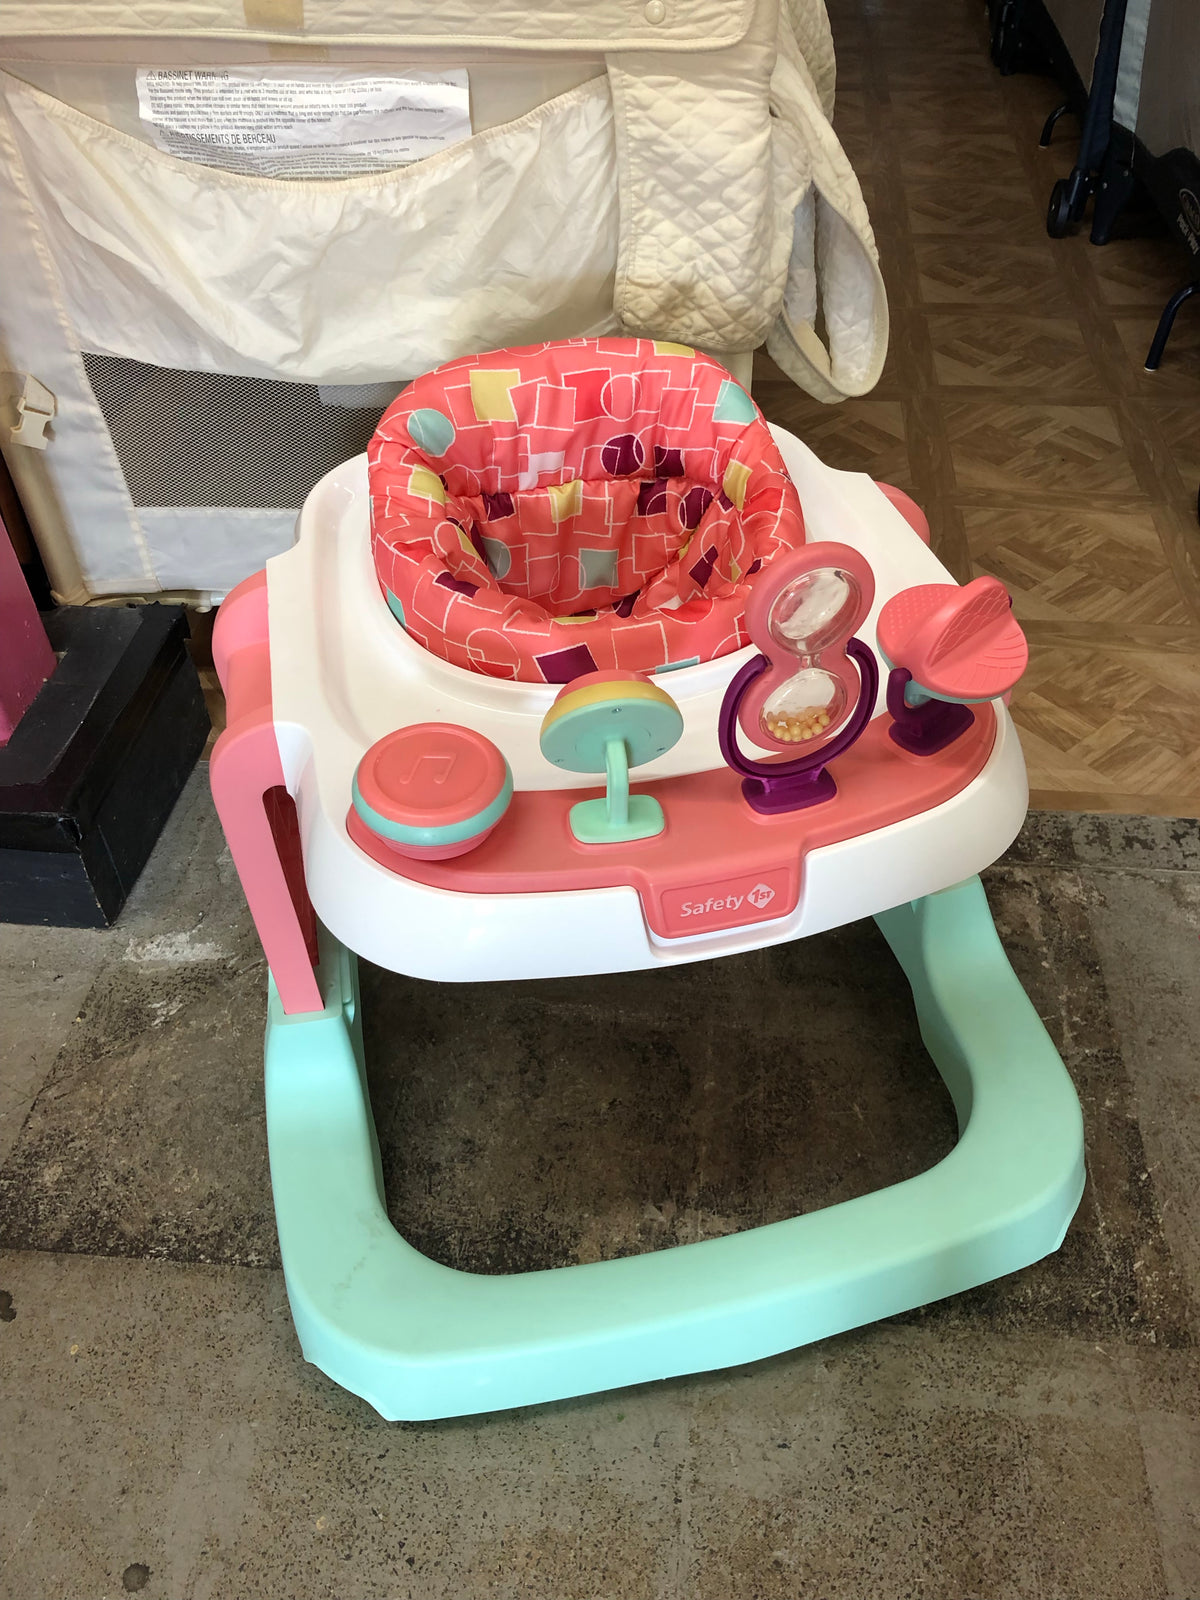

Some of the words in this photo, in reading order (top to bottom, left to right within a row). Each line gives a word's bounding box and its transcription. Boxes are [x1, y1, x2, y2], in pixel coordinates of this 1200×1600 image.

[158, 71, 192, 80] BASSINET
[194, 72, 229, 80] WARNG
[168, 130, 230, 144] VERTISSEMENTS
[232, 134, 241, 144] DE
[243, 134, 276, 144] BERCEAU
[680, 895, 744, 918] Safety
